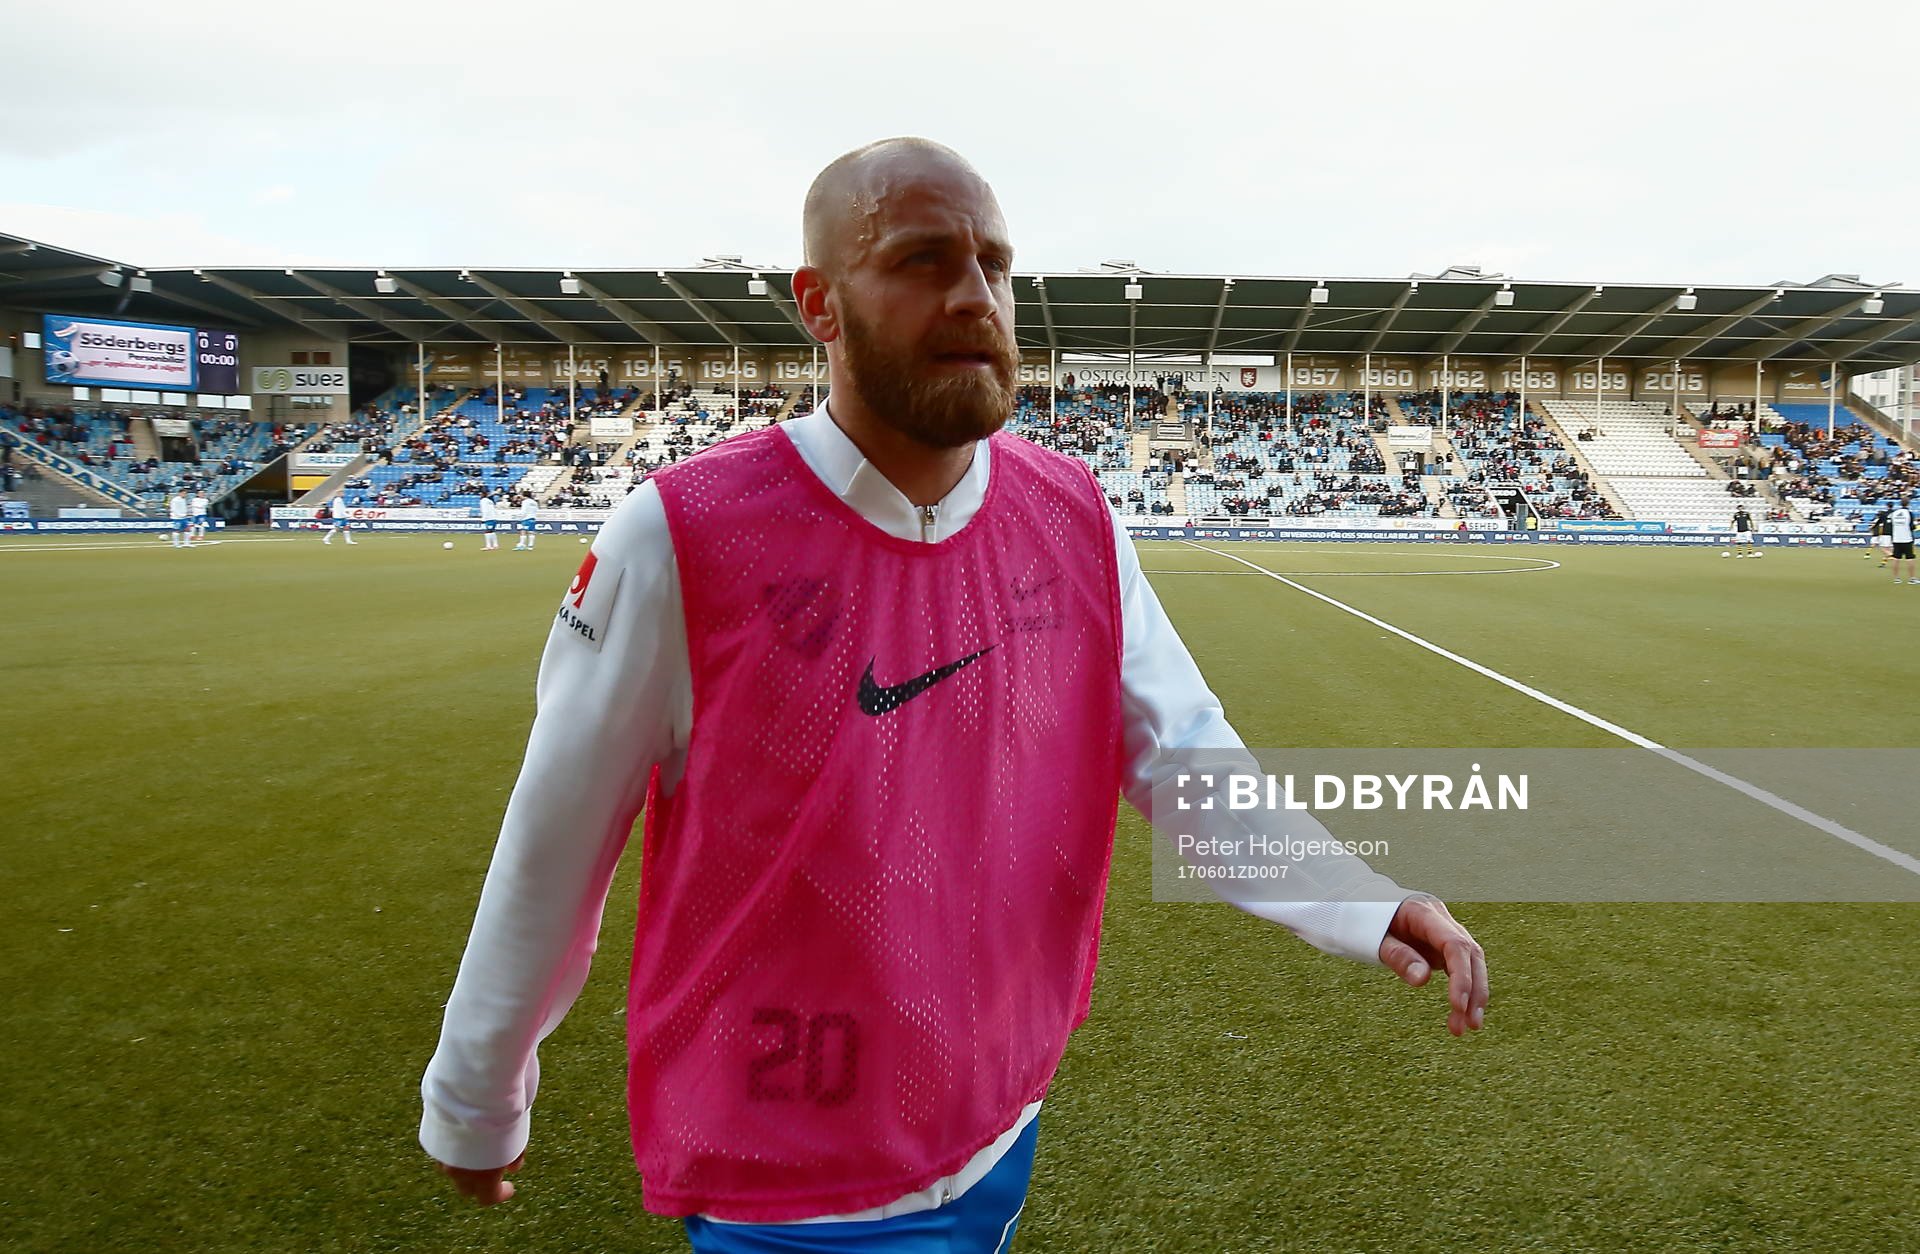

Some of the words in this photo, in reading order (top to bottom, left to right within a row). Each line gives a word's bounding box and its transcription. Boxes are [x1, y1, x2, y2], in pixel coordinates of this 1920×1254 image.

[80, 333, 185, 355] Söderbergs
[200, 338, 209, 348] 0
[225, 340, 234, 350] 0
[128, 353, 185, 364] Personbilar
[200, 353, 235, 365] 00:00
[623, 360, 683, 377] 1945
[701, 361, 758, 378] 1946
[775, 361, 828, 379] 1947
[1288, 367, 1340, 386] 1957
[1358, 368, 1414, 387] 1960
[295, 373, 344, 387] suez
[1430, 370, 1485, 388] 1962
[1502, 371, 1556, 389] 1963
[1644, 373, 1703, 391] 2015
[569, 615, 596, 642] SPEL
[749, 1007, 859, 1107] 20
